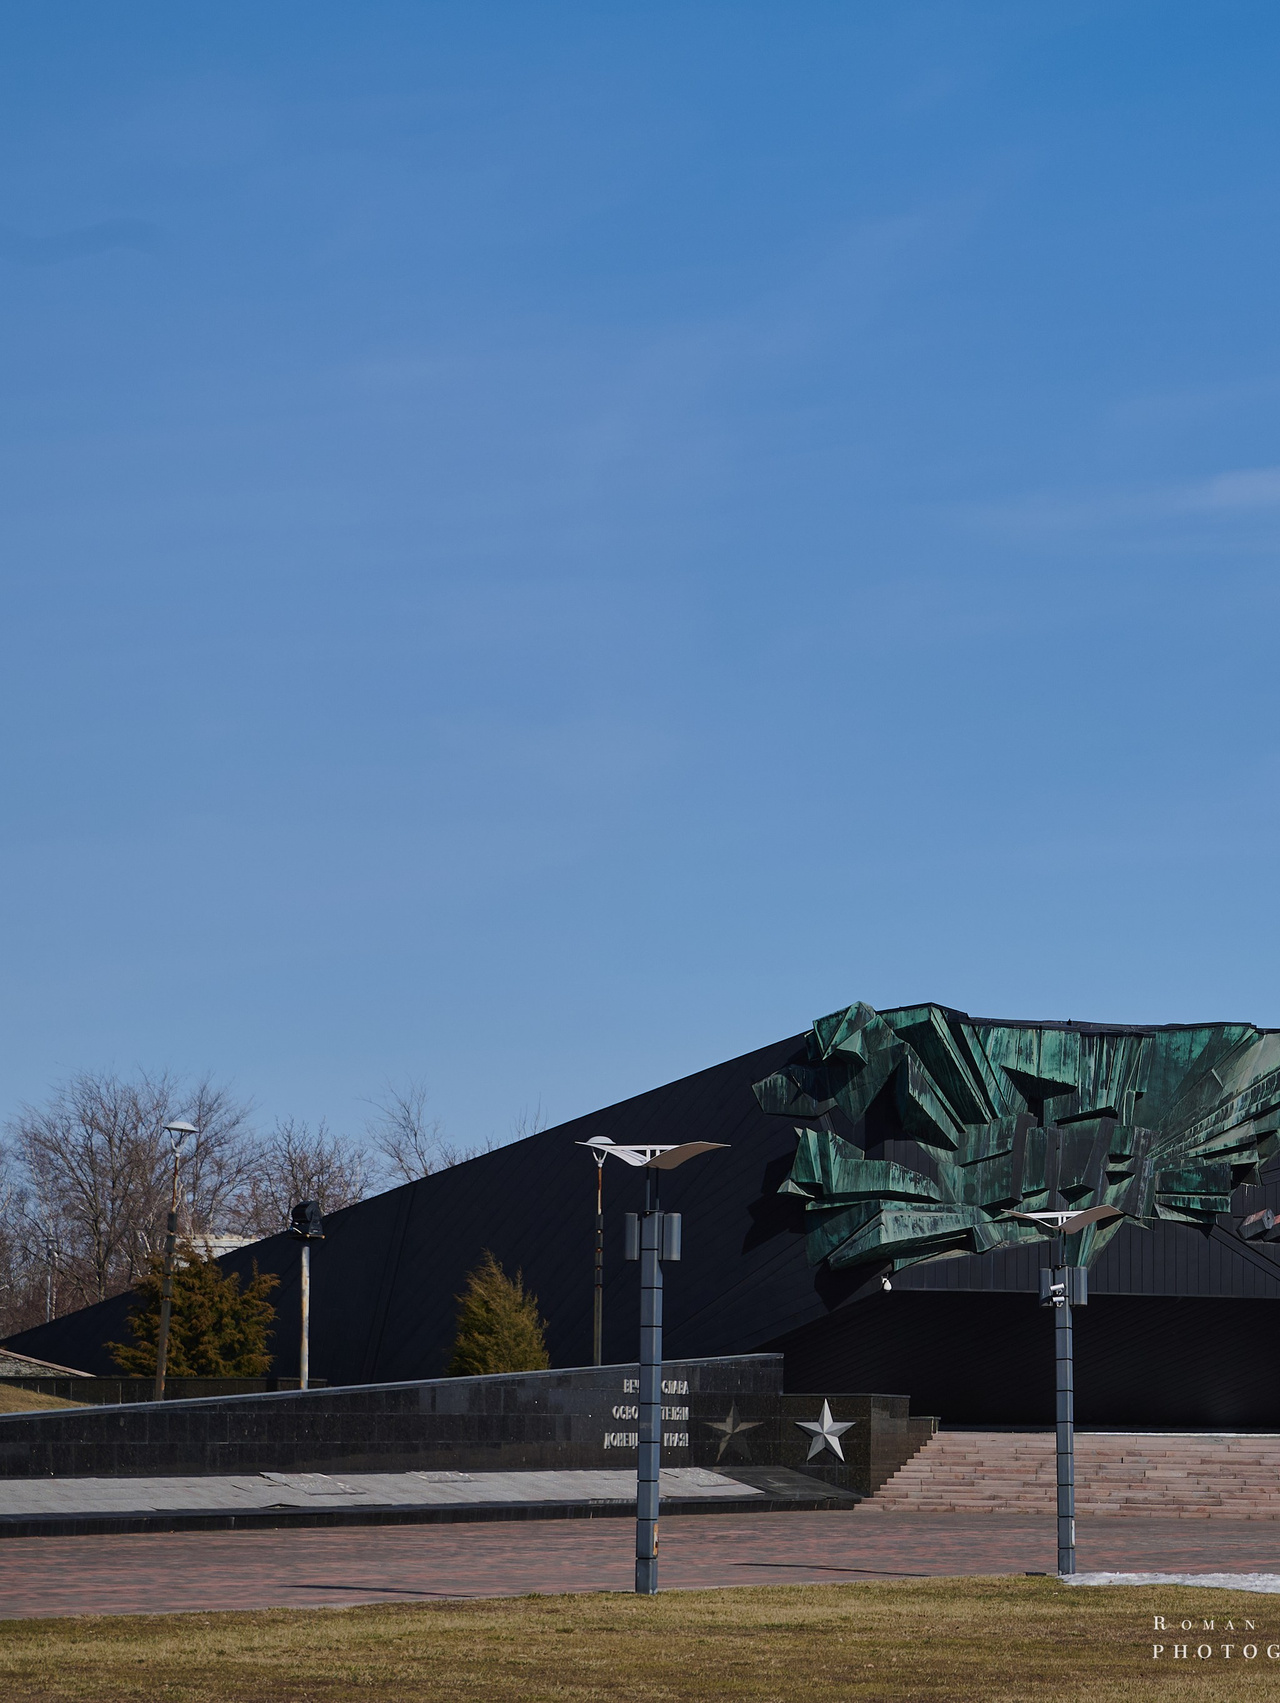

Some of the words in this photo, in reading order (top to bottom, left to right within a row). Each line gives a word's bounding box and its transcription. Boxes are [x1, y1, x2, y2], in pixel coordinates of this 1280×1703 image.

[661, 1380, 690, 1395] СЛАВА
[612, 1405, 690, 1420] ОСВОТЕЛЯМ
[663, 1432, 690, 1447] КРАЯ!
